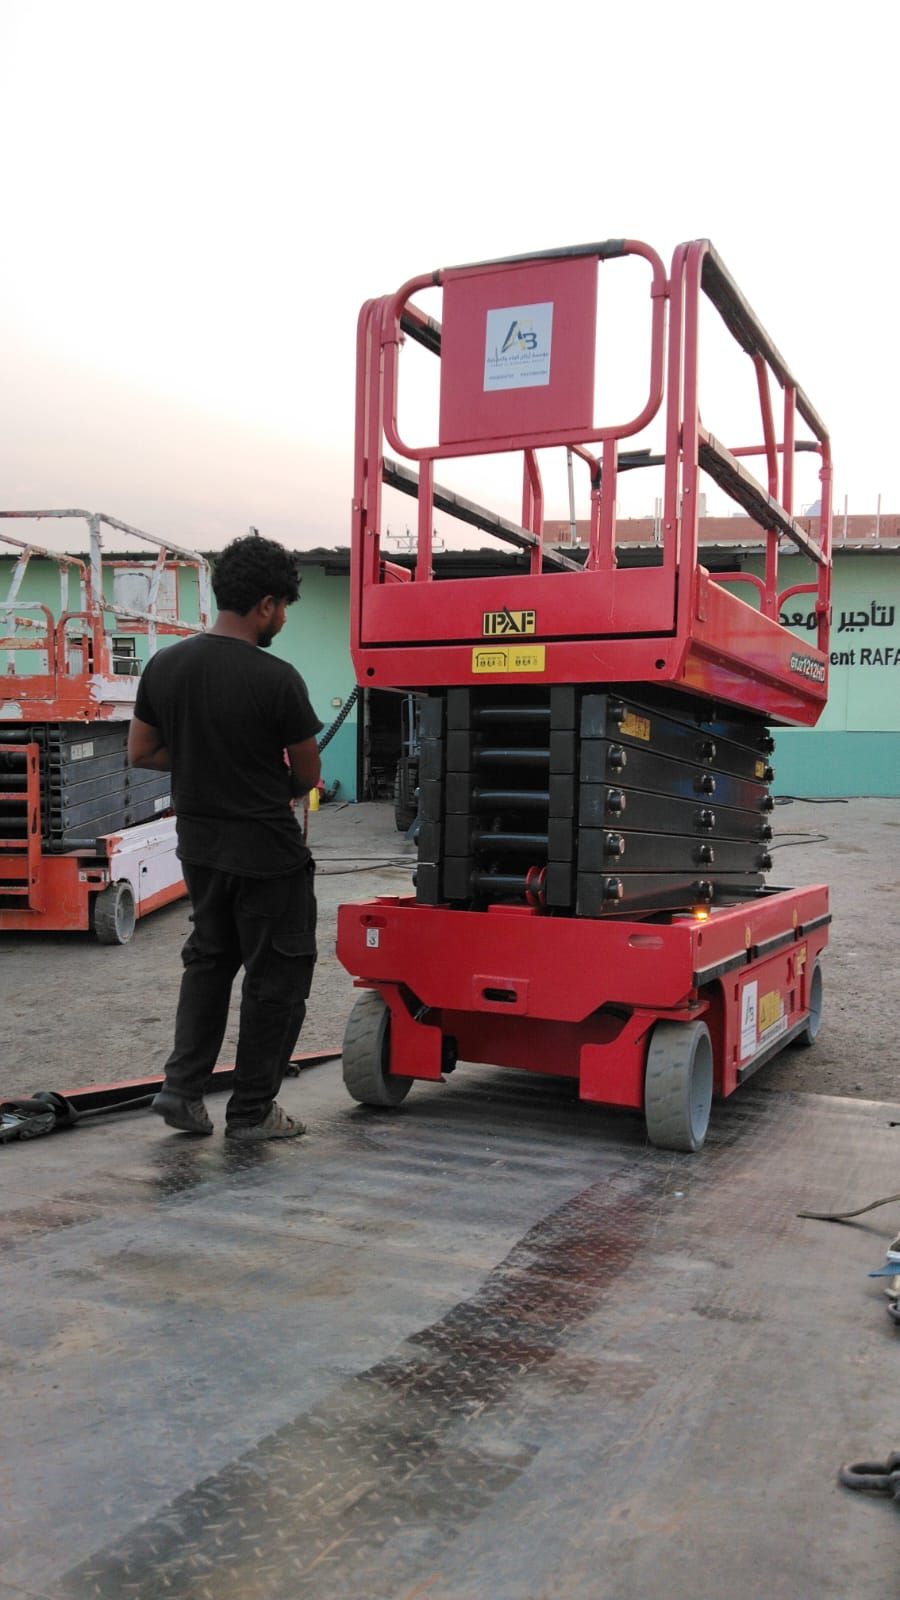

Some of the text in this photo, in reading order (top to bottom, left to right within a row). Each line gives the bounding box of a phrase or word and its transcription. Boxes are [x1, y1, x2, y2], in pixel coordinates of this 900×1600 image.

[484, 606, 534, 634] IPAF
[837, 600, 895, 633] لتأجير
[830, 648, 856, 666] ent
